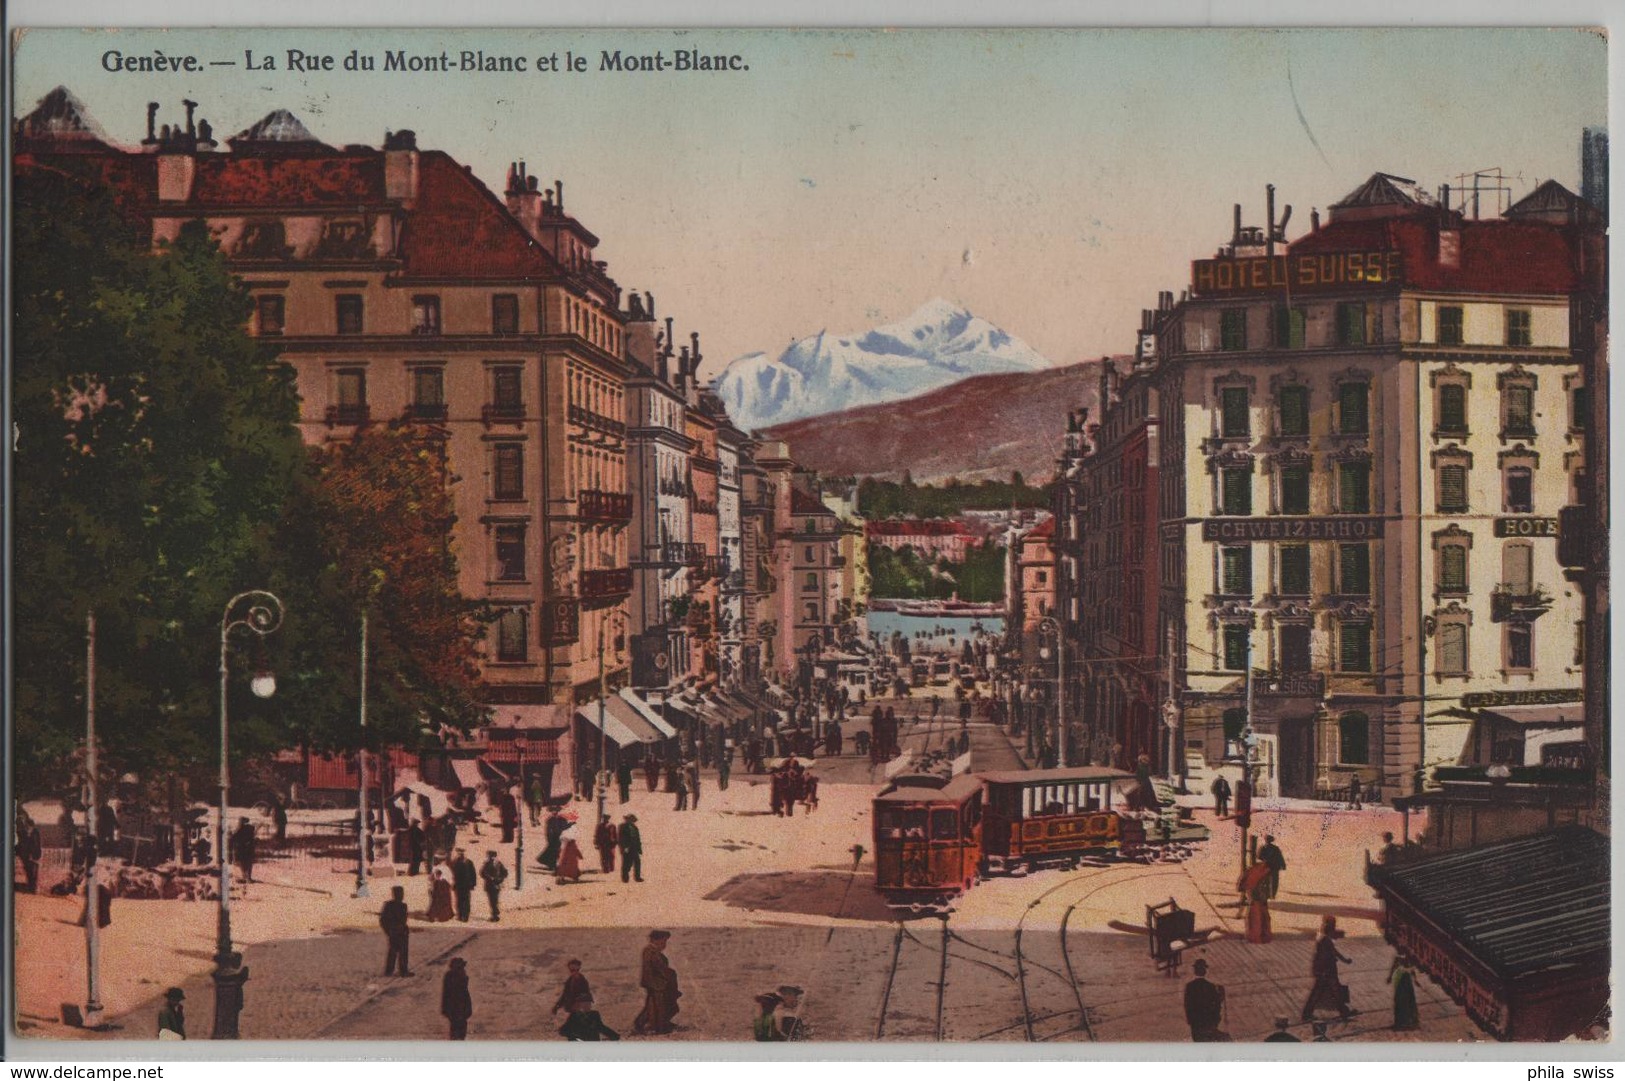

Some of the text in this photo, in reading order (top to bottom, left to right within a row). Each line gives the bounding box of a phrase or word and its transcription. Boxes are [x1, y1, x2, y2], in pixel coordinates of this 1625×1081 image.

[102, 50, 203, 72] Genève.
[245, 50, 276, 70] La
[287, 49, 334, 72] Rue
[344, 50, 374, 71] du
[384, 51, 527, 72] Mont-Blanc
[537, 53, 558, 72] et
[566, 51, 587, 72] le
[600, 50, 749, 71] Mont-Blanc.
[1200, 251, 1400, 290] HOTEL SUISSE
[1208, 520, 1379, 538] SCHWEIZERHOF
